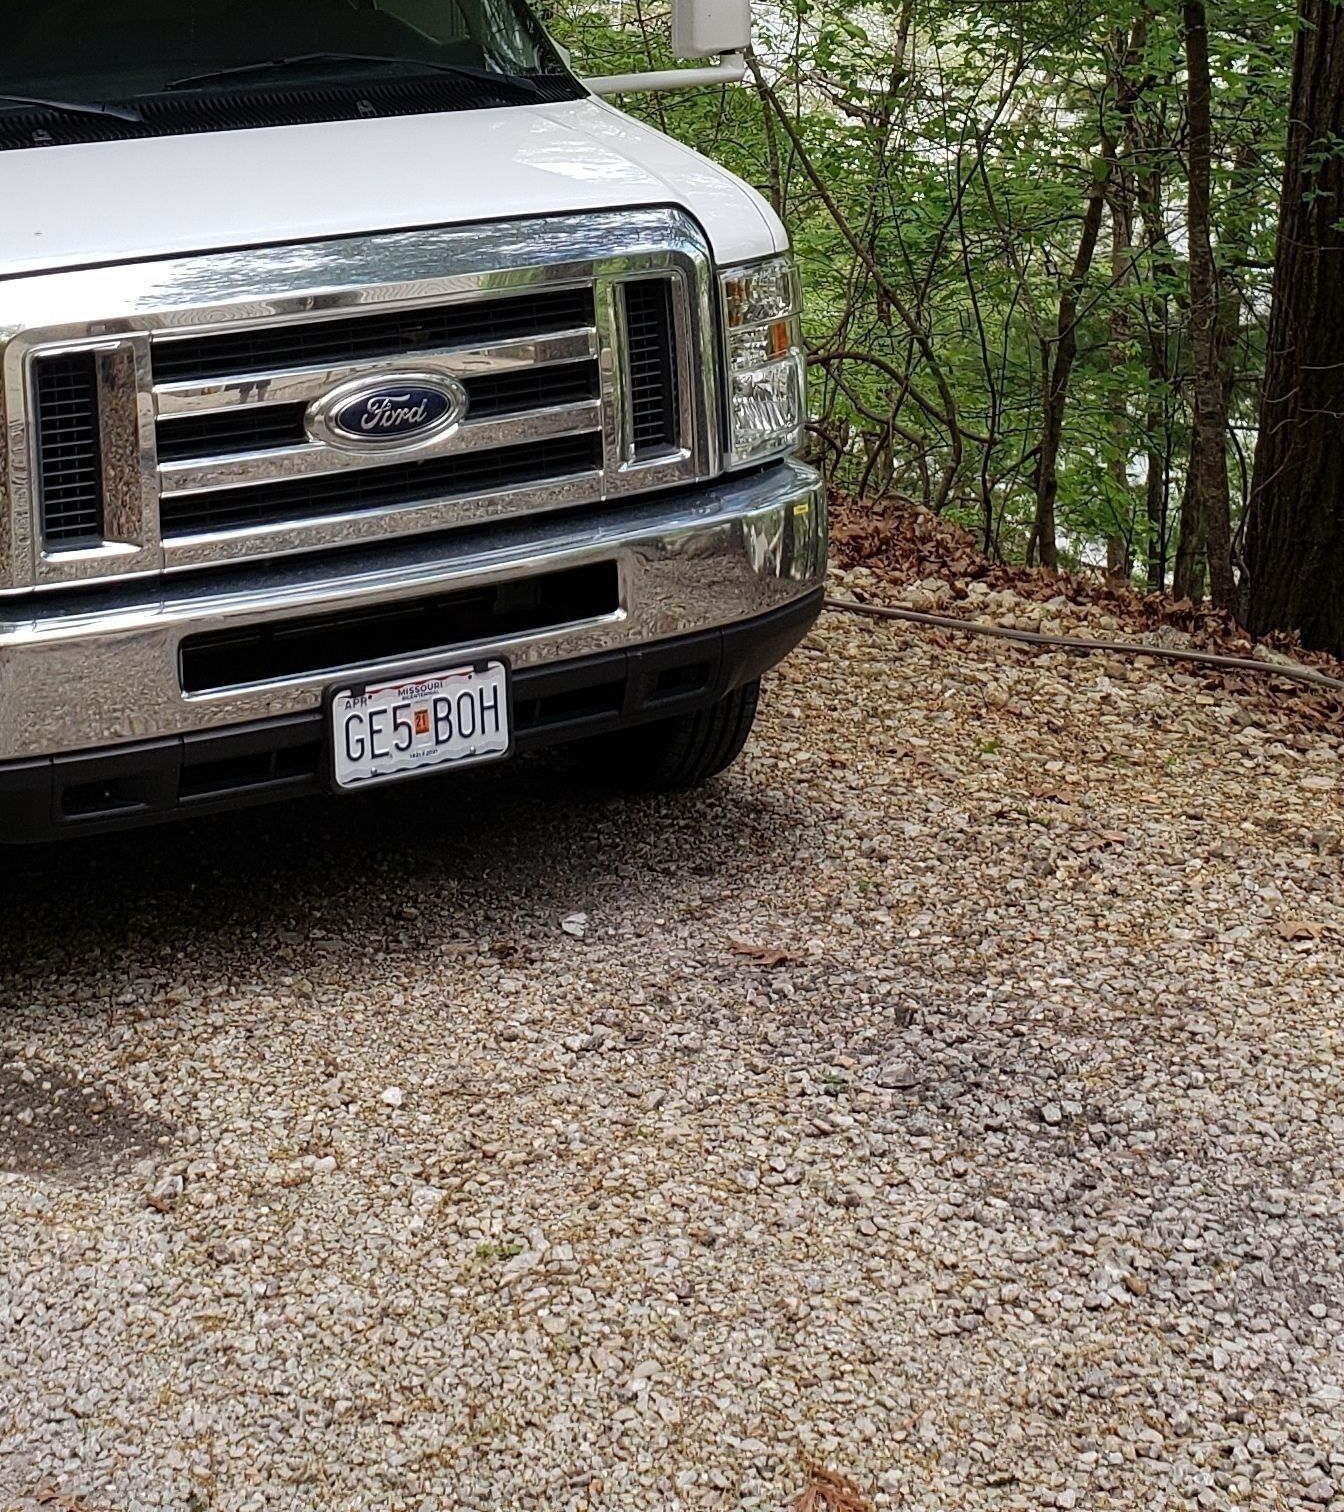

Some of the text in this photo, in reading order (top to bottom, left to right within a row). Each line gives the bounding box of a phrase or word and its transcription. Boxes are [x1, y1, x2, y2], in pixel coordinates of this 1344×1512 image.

[361, 394, 428, 430] Ford
[398, 680, 443, 696] MISSOURI
[344, 696, 367, 710] APR
[415, 713, 426, 728] 21
[344, 702, 412, 762] GE5
